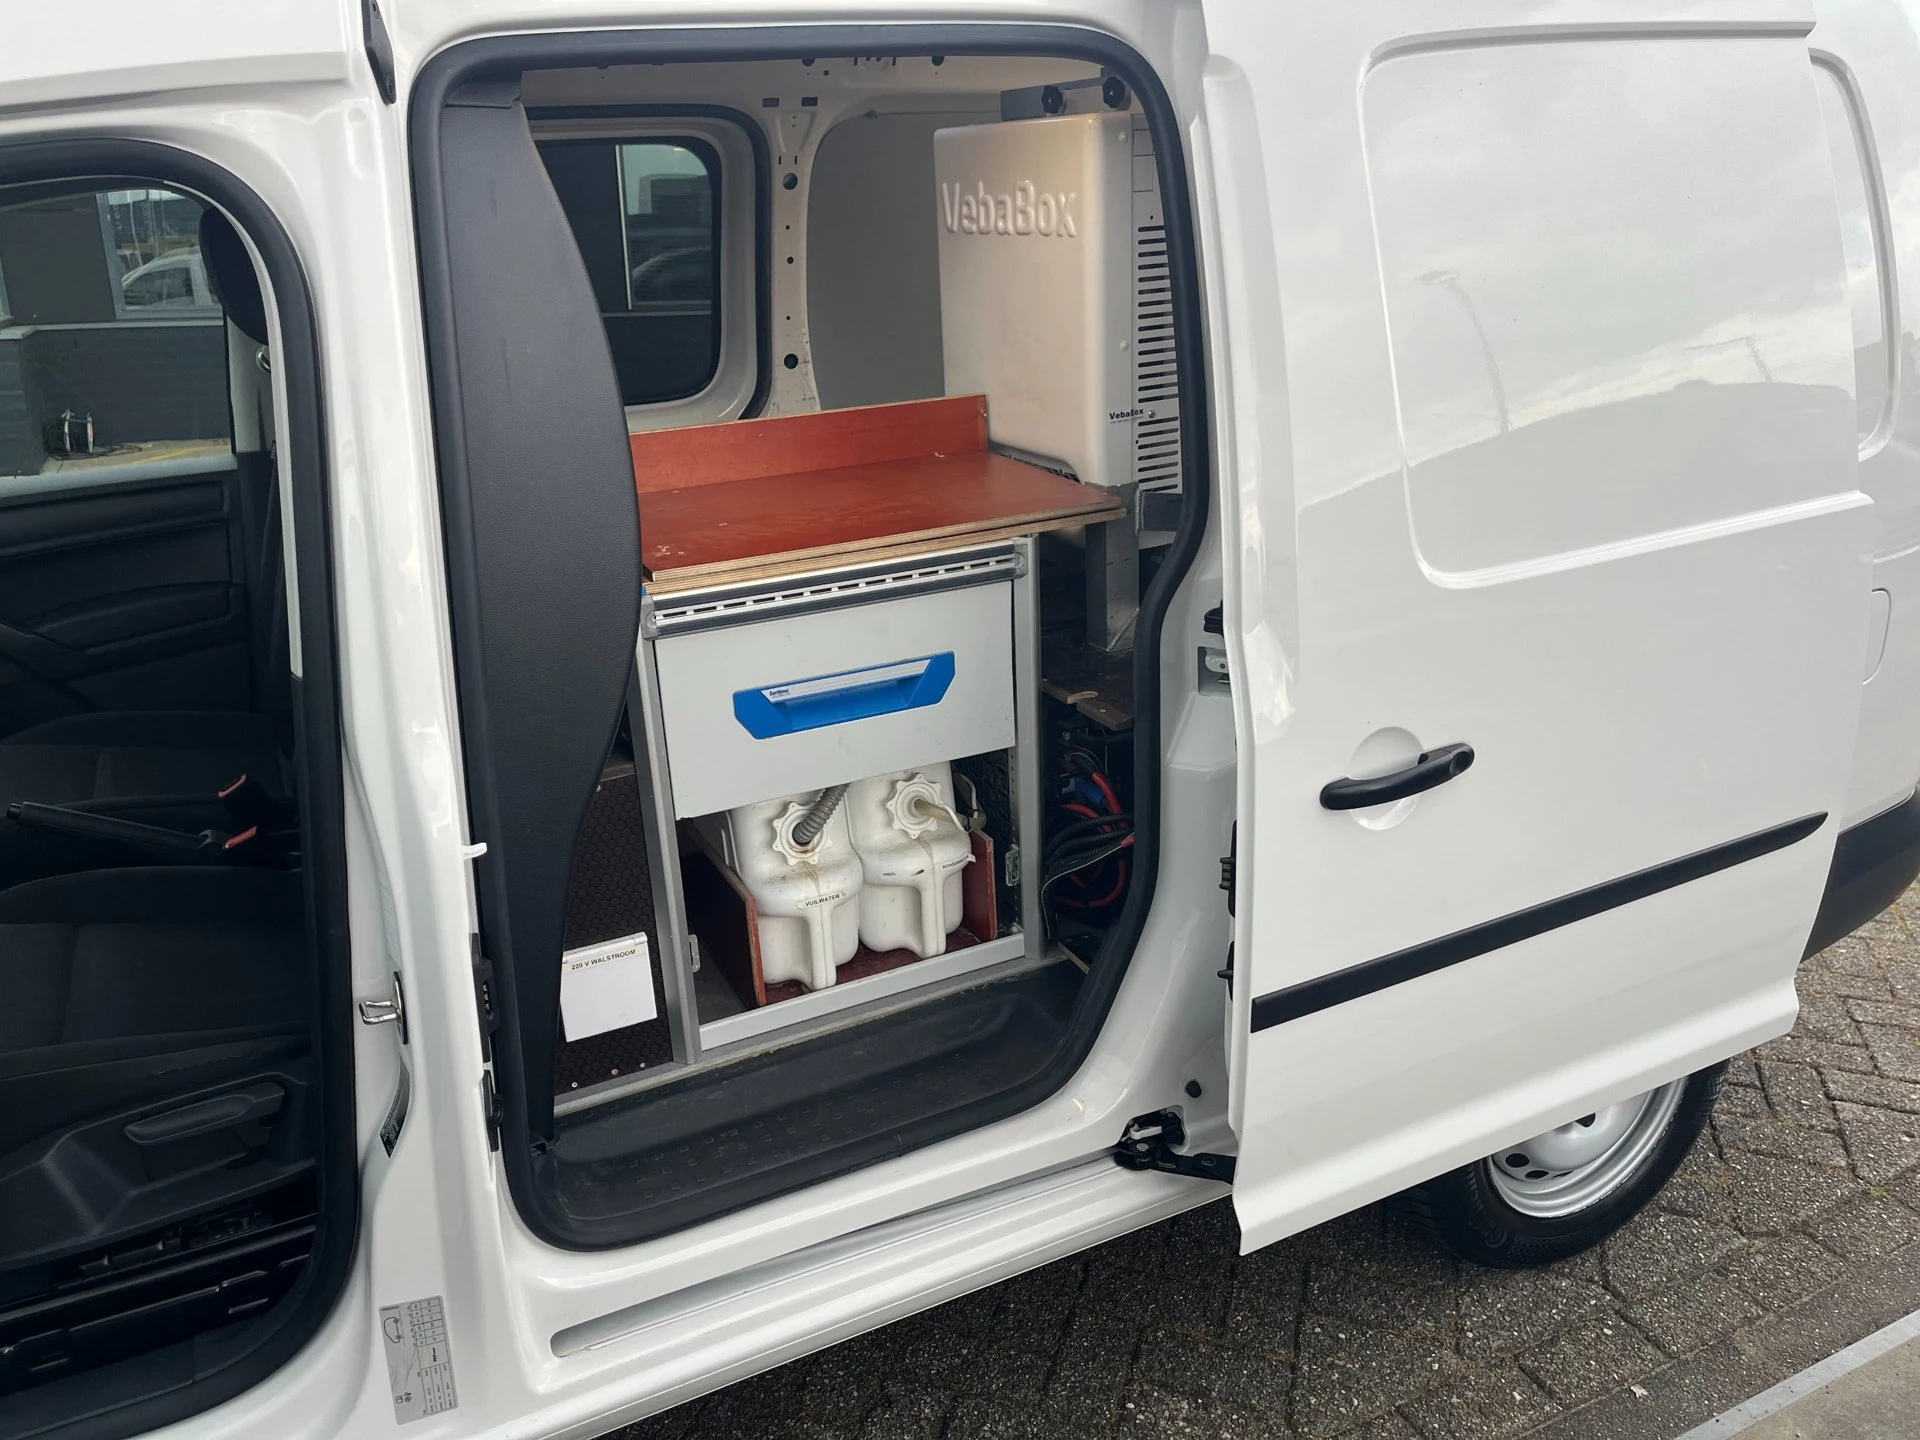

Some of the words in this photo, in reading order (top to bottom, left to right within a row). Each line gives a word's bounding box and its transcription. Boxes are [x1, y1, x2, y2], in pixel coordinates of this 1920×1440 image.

[942, 179, 1077, 238] VebaBox
[805, 893, 840, 907] VUILWATER
[571, 962, 583, 970] 220
[590, 949, 636, 965] WALSTROOM
